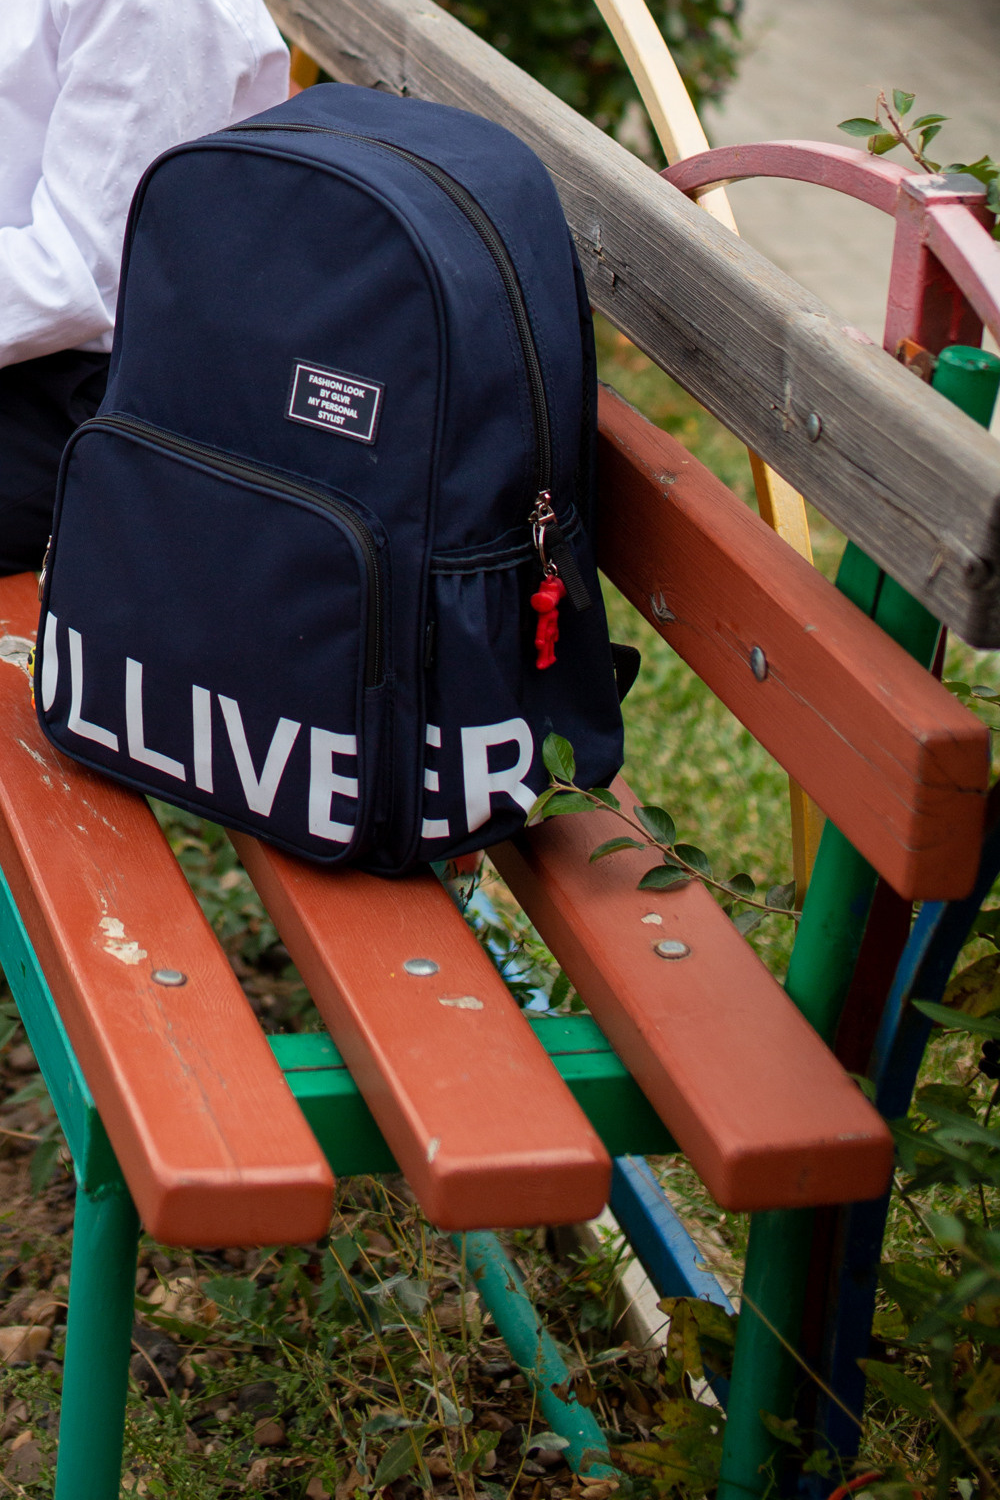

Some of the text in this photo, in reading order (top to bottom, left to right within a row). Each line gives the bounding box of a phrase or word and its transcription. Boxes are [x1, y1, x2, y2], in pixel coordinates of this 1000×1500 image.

[308, 374, 366, 398] FASHION LOOK
[319, 388, 351, 405] BY GLVR
[307, 396, 358, 419] MY PERSONAL
[317, 410, 346, 425] STYLIST
